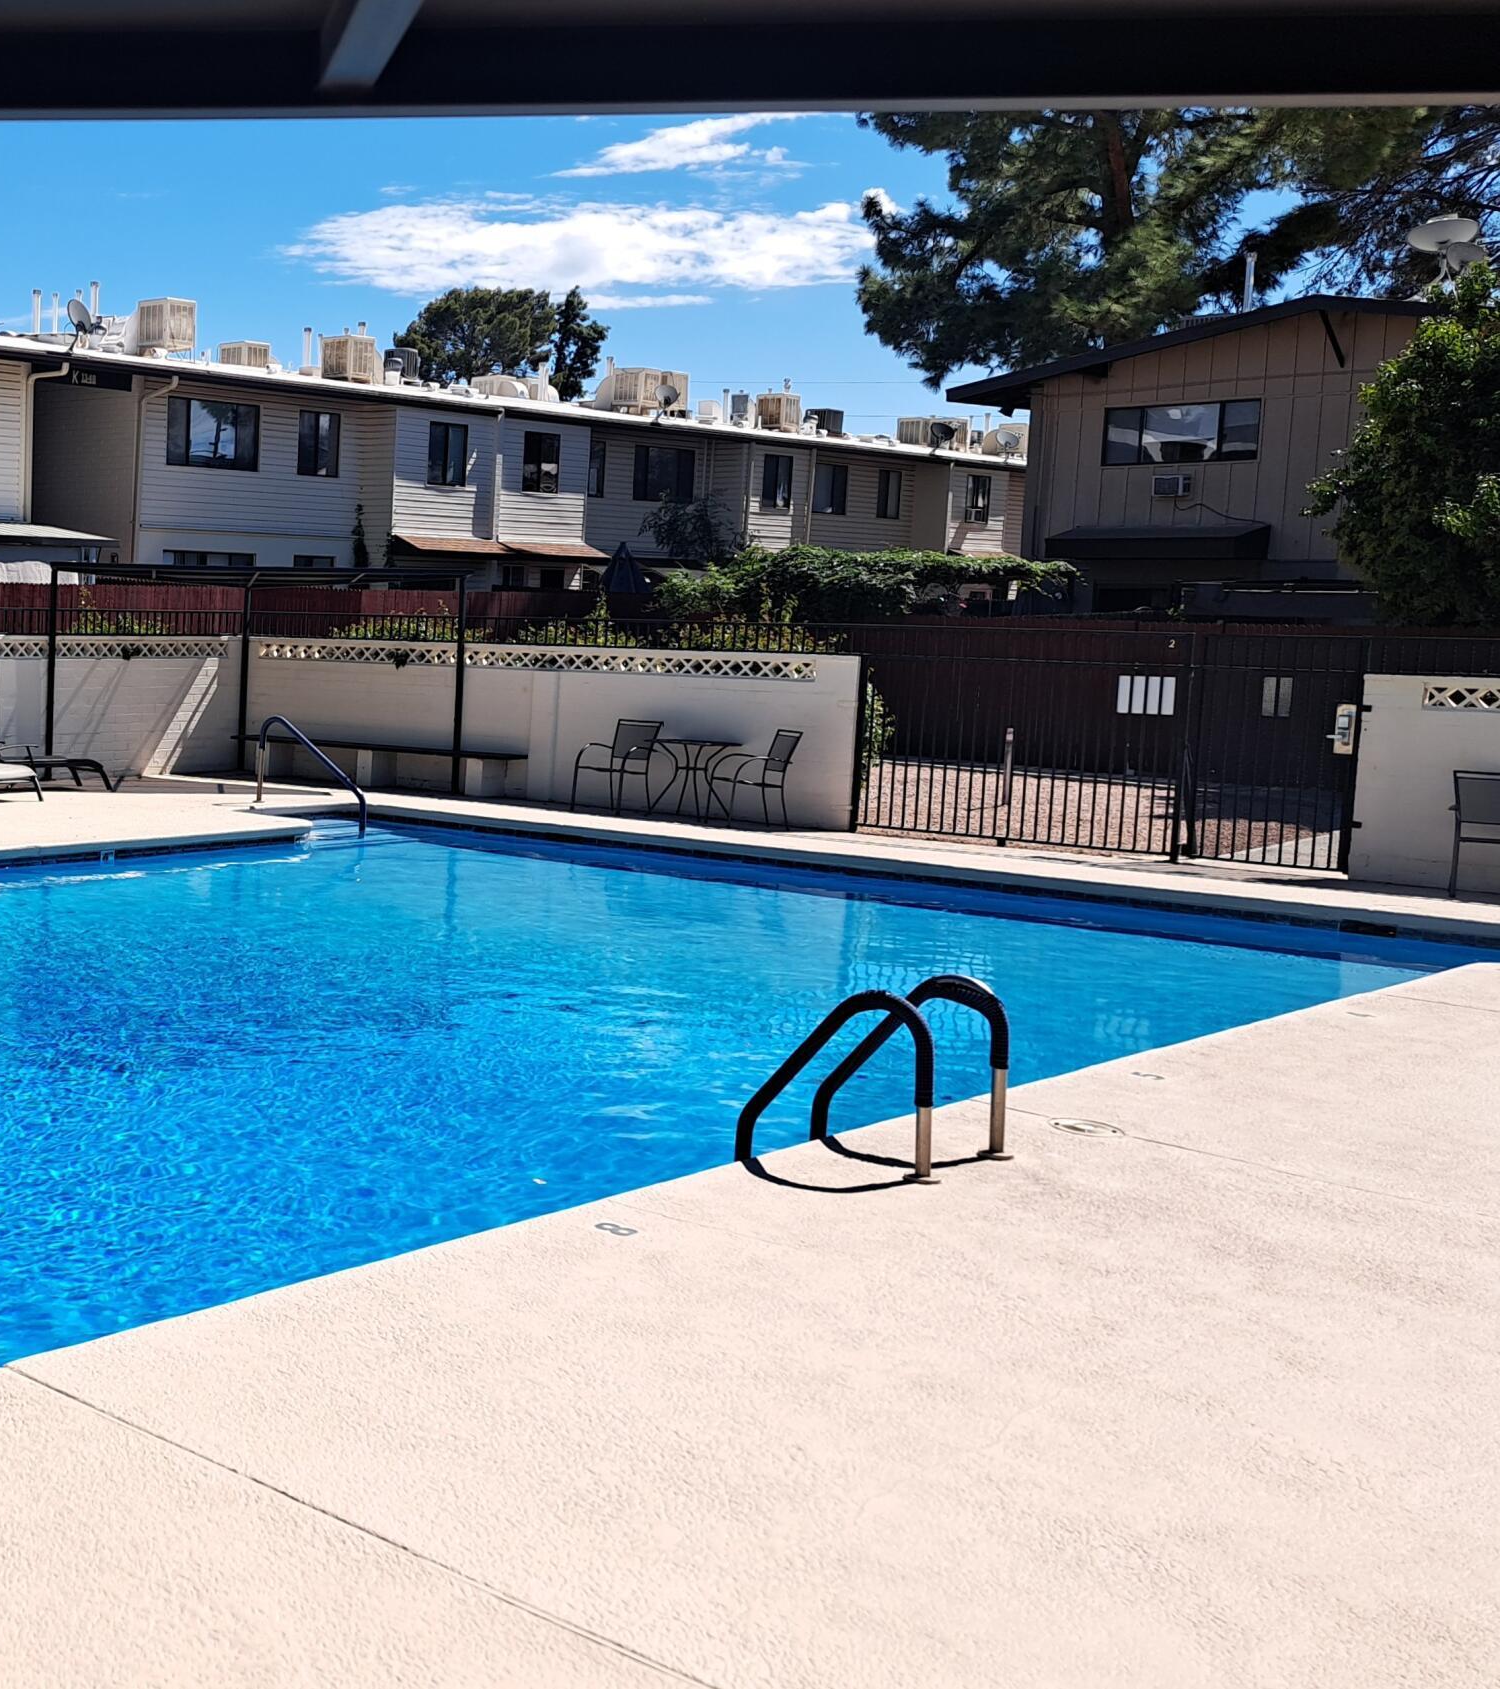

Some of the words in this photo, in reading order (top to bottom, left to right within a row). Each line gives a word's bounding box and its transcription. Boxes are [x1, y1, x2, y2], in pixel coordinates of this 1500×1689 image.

[72, 370, 79, 384] K
[1168, 639, 1176, 648] 2
[595, 1222, 638, 1236] 8
